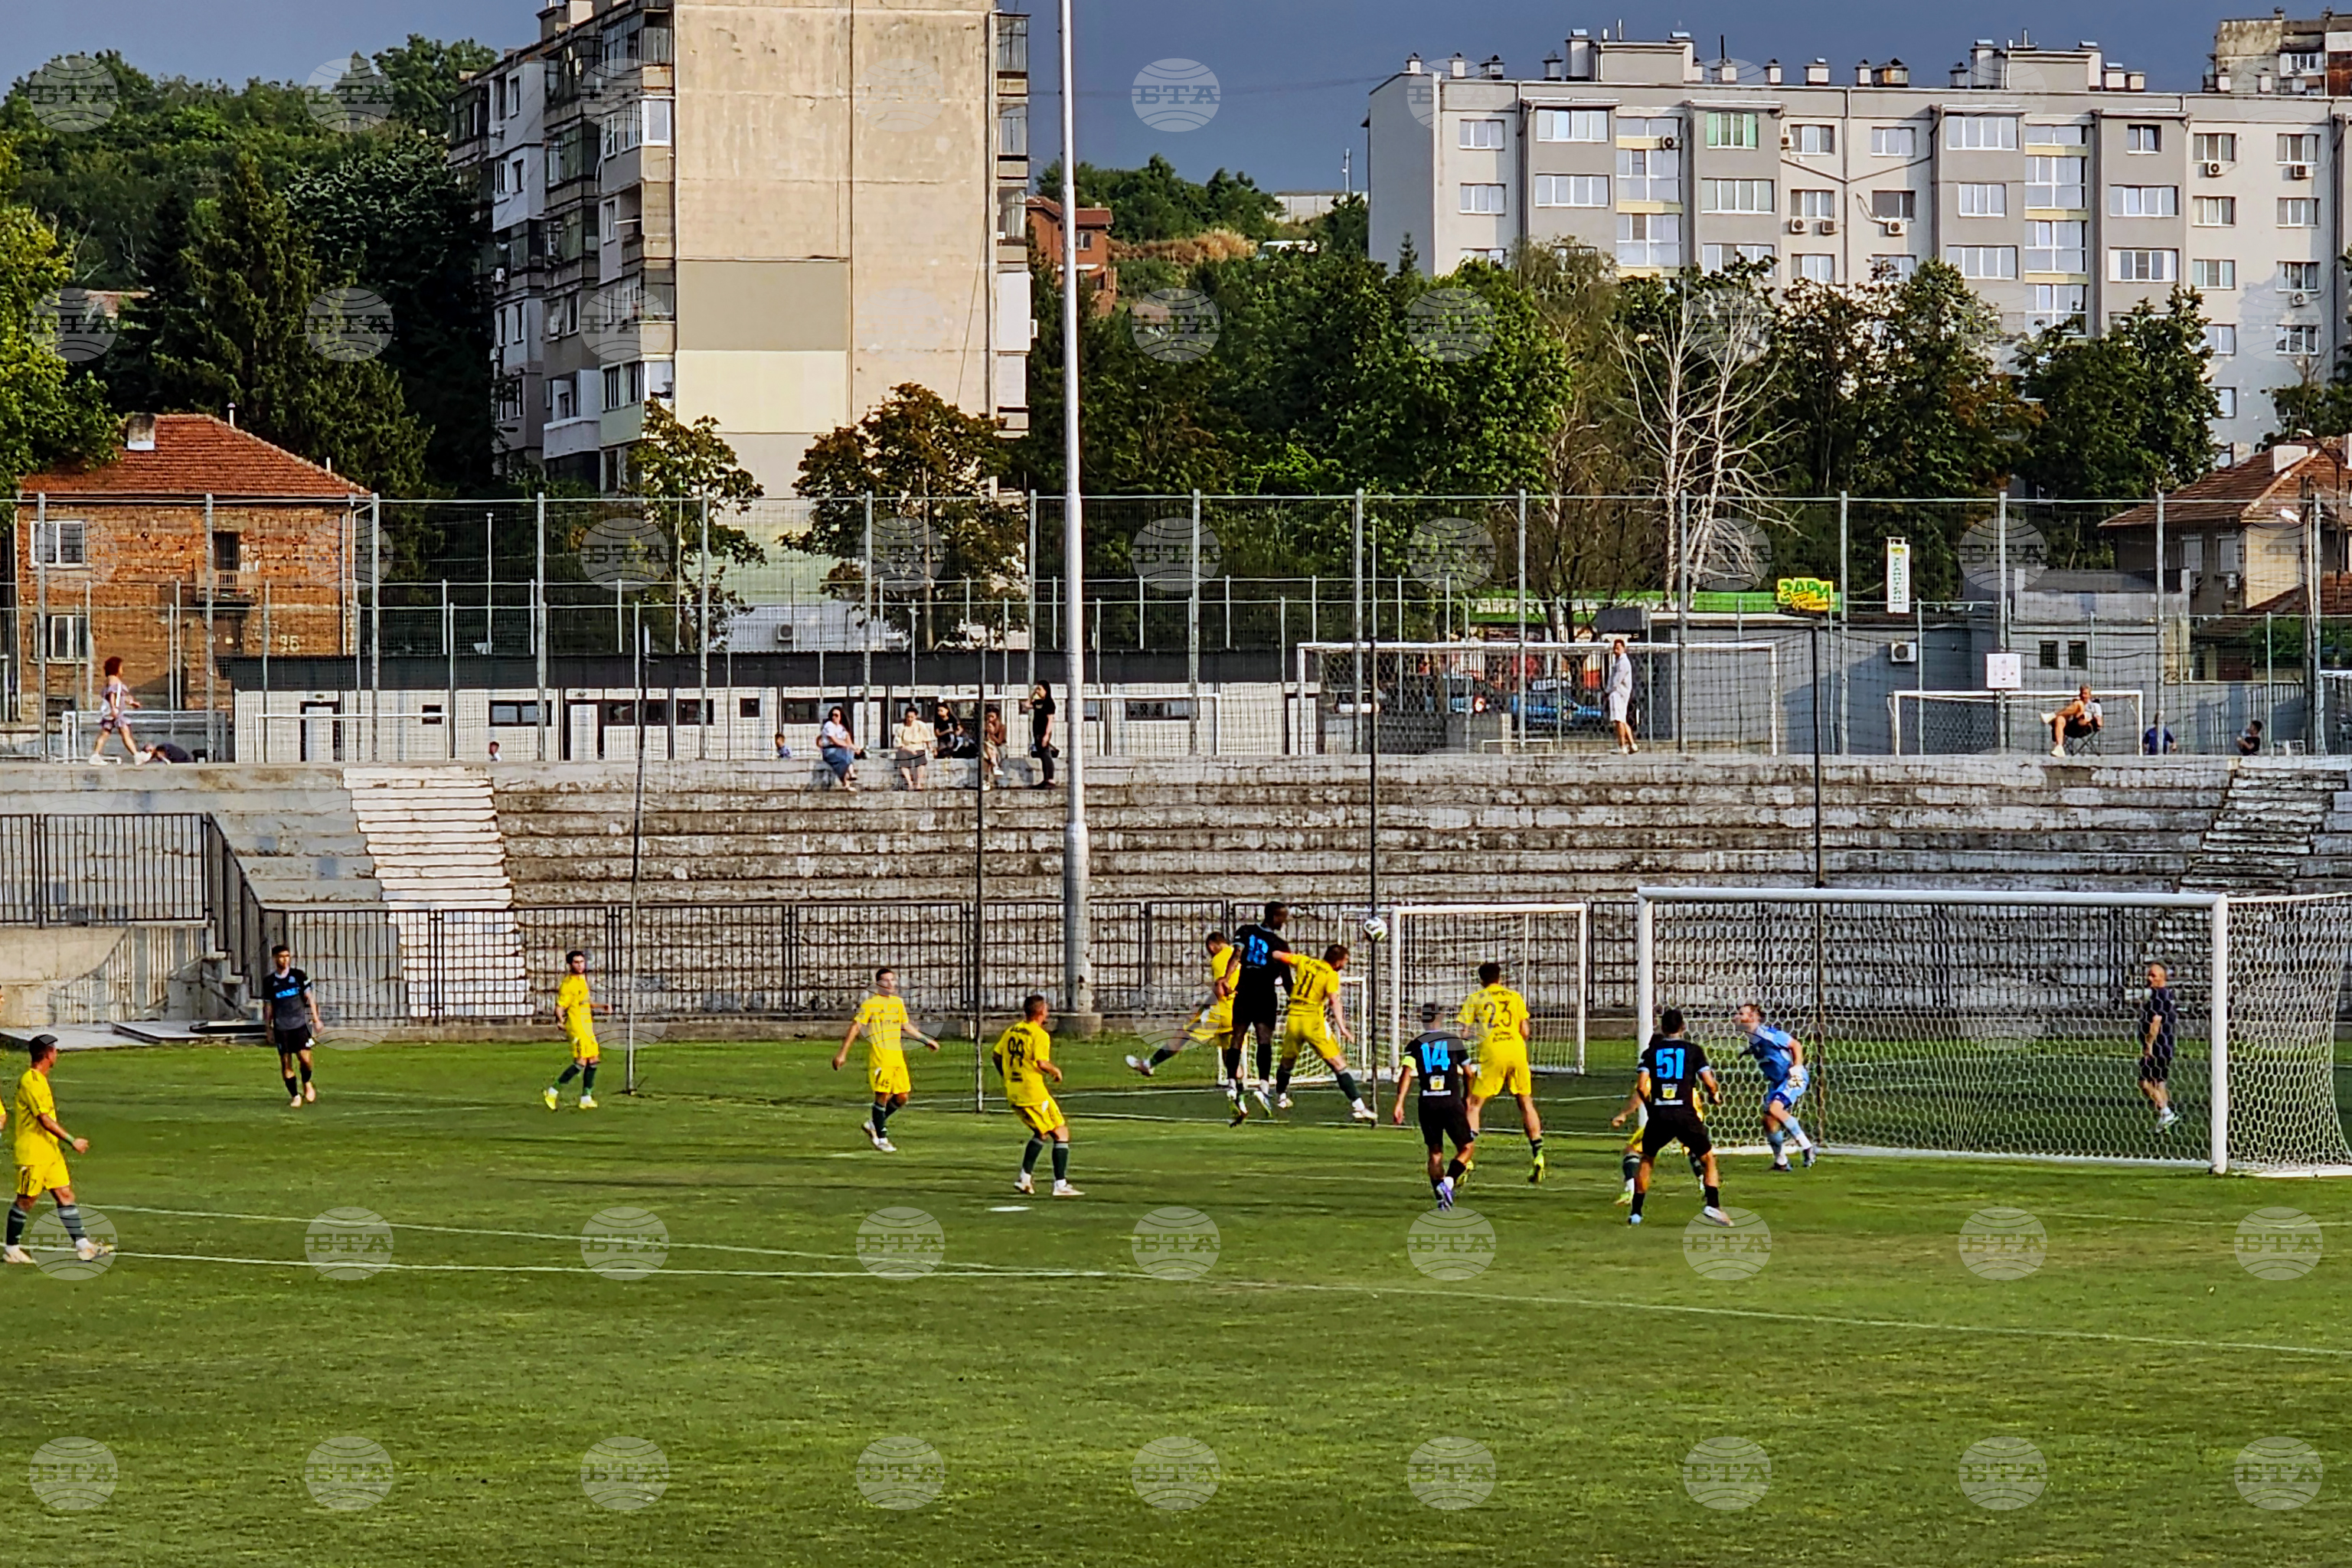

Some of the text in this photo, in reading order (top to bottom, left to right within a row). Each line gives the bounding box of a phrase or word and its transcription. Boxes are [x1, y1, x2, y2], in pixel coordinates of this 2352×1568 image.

[1296, 970, 1315, 998] 11
[1483, 1000, 1511, 1030] 23
[1008, 1036, 1024, 1067] 99
[1420, 1040, 1451, 1073] 14
[1655, 1047, 1686, 1080] 51
